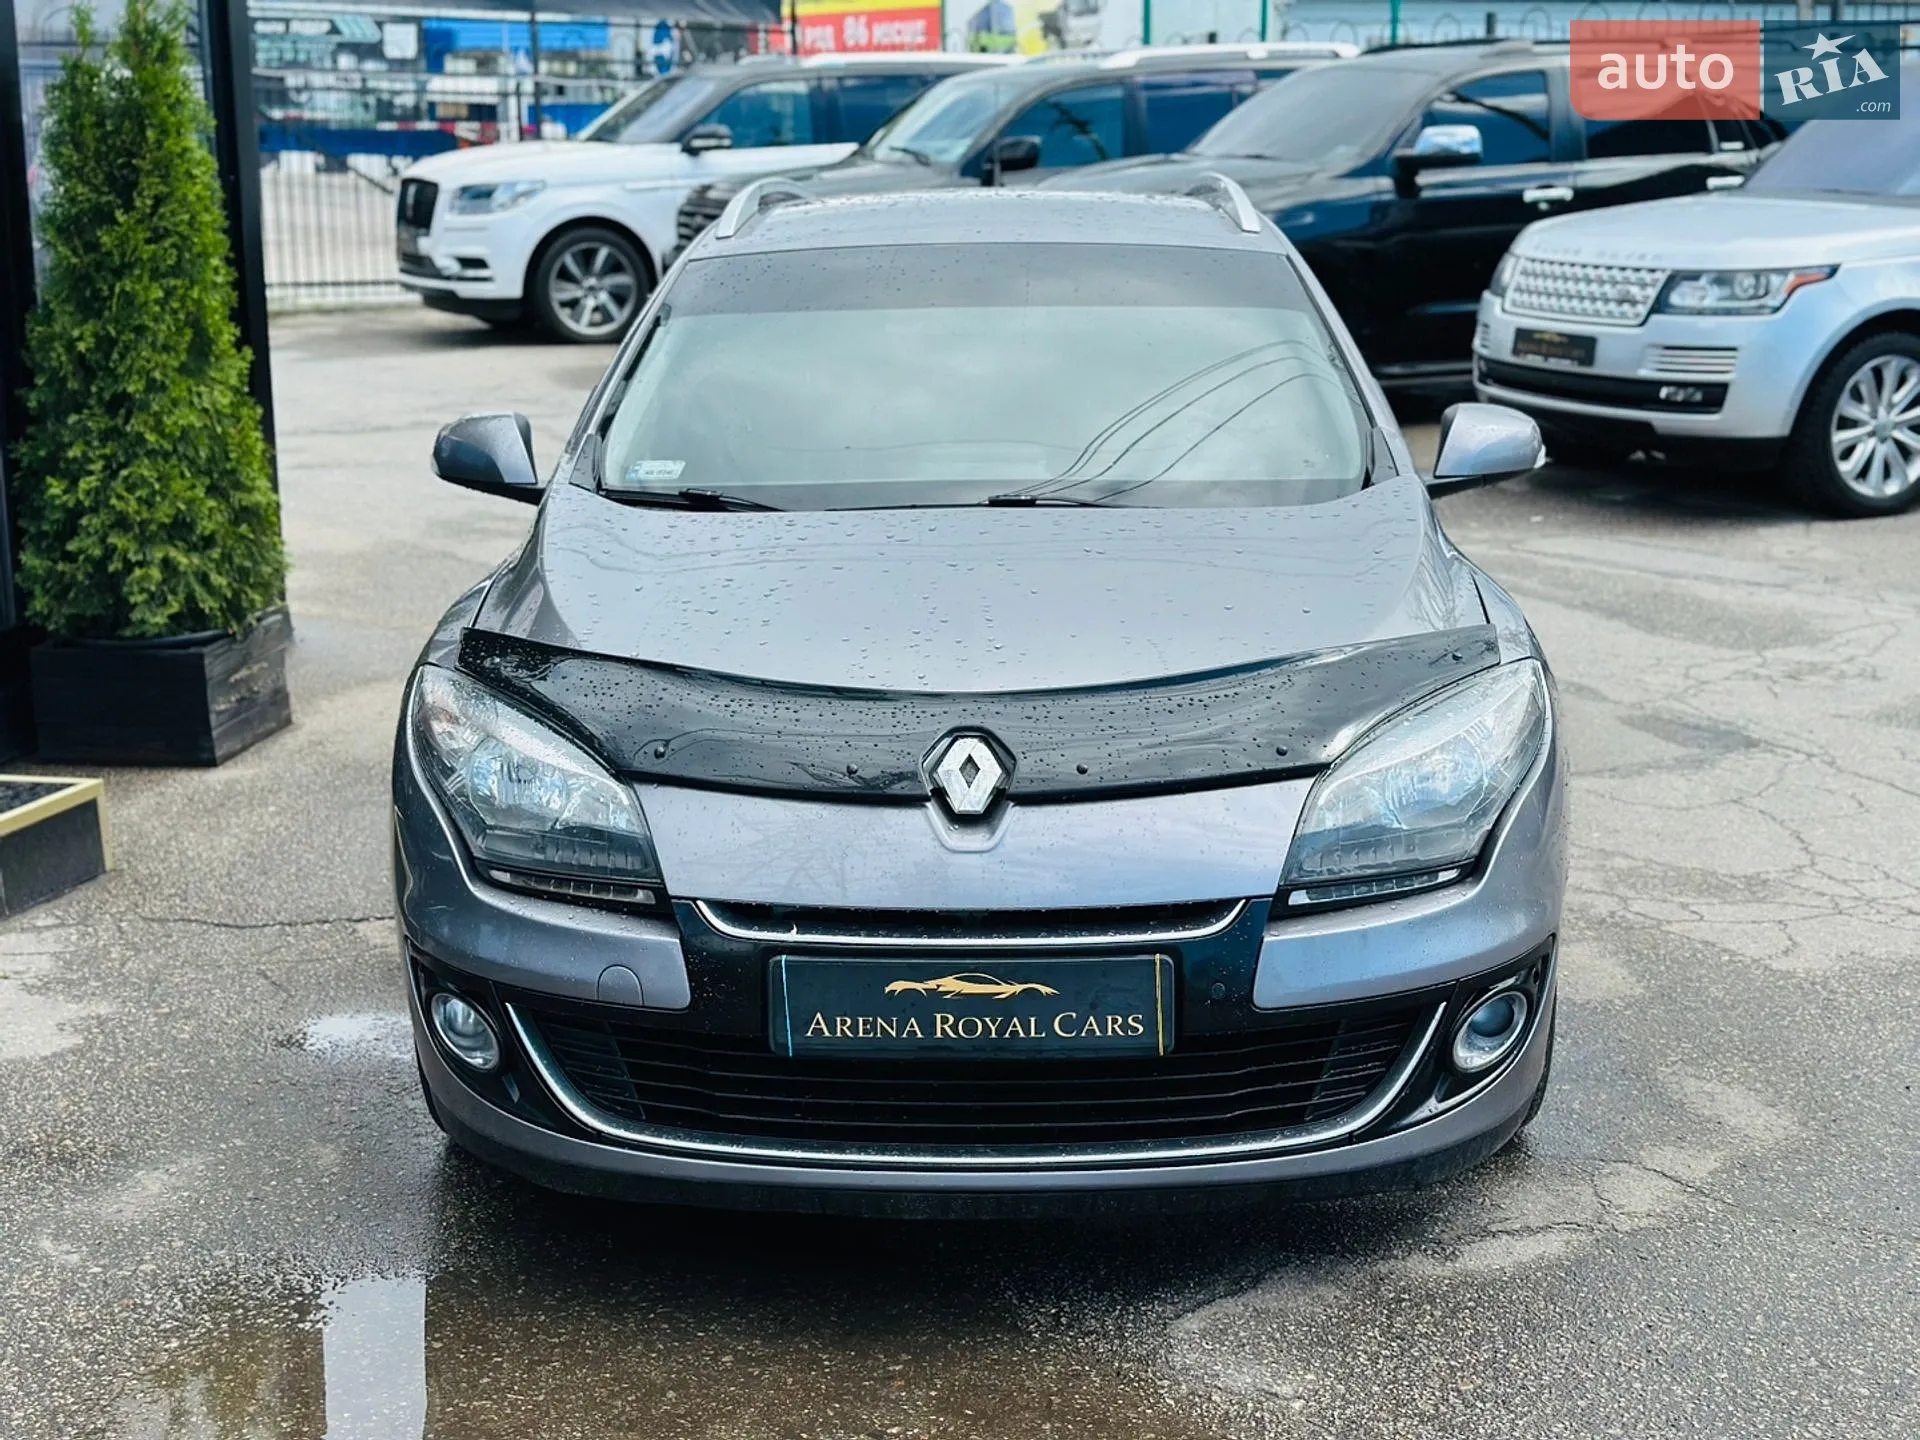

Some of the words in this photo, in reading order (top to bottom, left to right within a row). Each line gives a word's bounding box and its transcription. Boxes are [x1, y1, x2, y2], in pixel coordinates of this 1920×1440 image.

[805, 1012, 924, 1038] ARENA
[933, 1013, 1046, 1039] ROYAL
[1053, 1012, 1144, 1038] CARS
